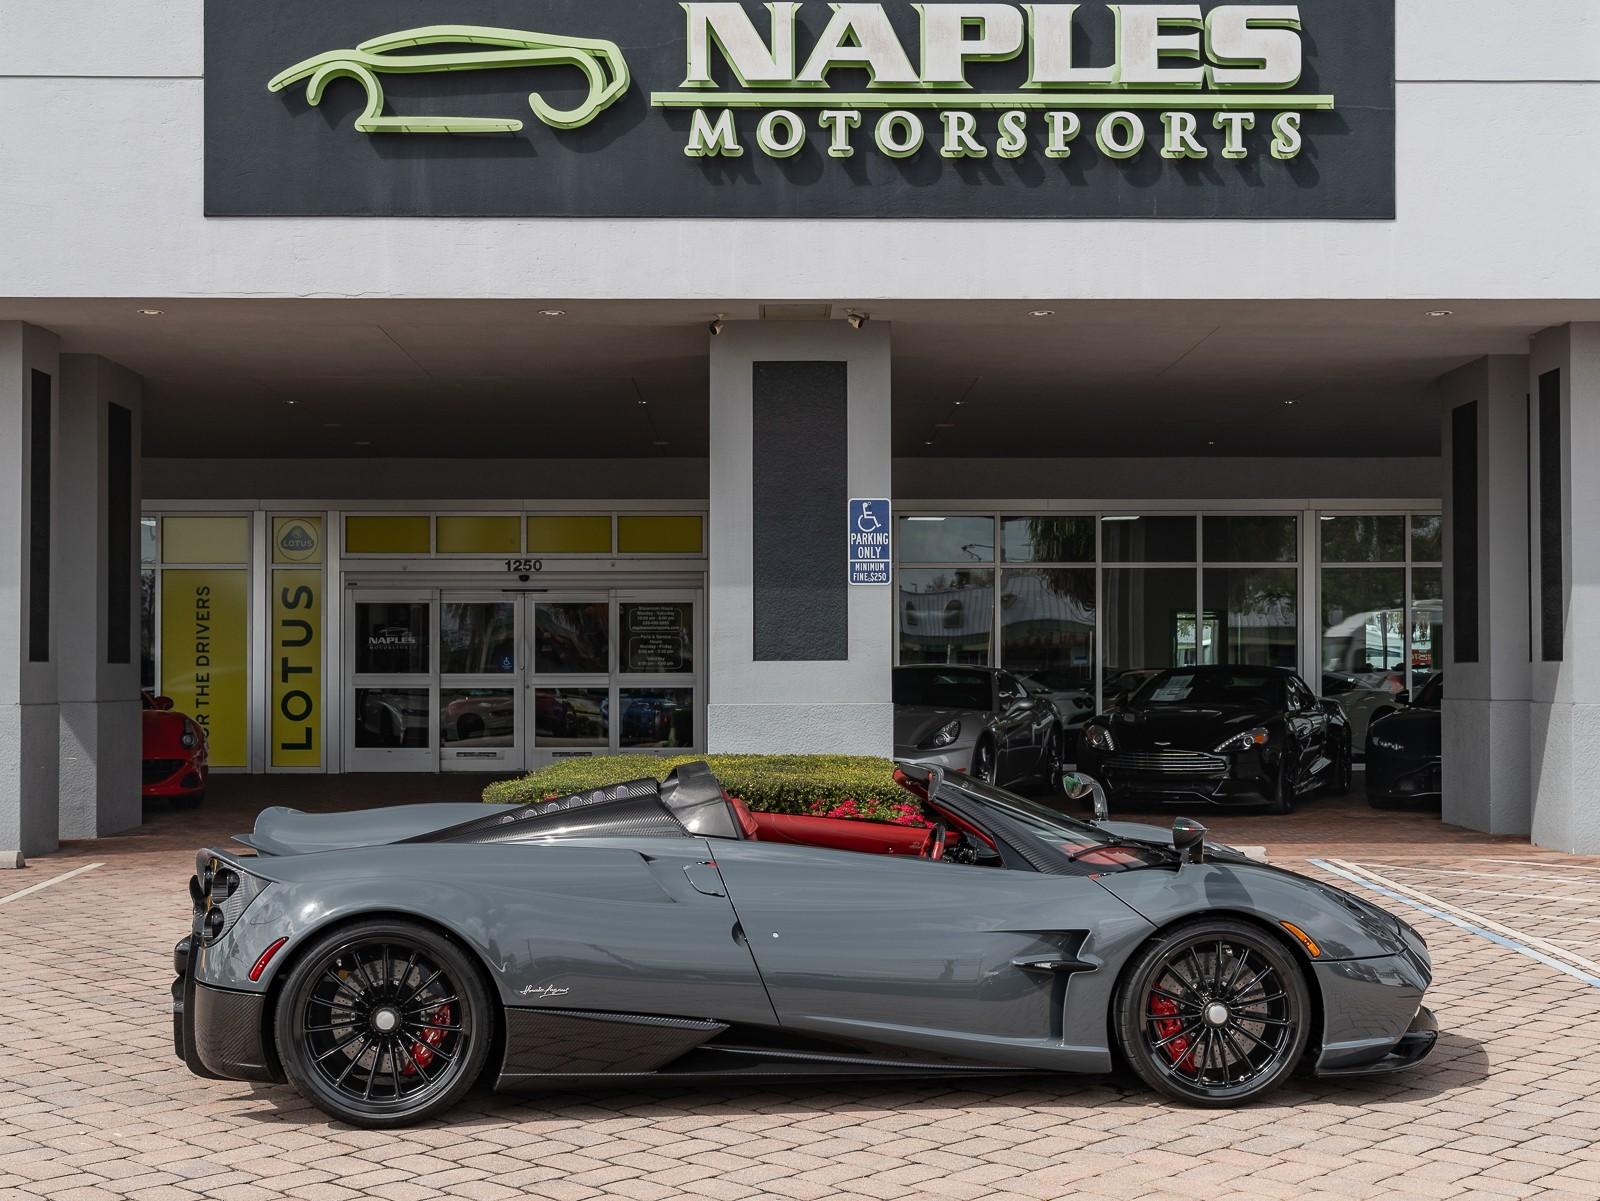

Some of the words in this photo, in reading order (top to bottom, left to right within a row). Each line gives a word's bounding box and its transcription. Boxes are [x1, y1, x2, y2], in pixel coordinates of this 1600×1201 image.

[680, 1, 1303, 90] NAPLES
[684, 108, 1303, 159] MOTORSPORTS
[850, 532, 888, 544] PARKING
[858, 546, 882, 558] ONLY
[504, 560, 543, 571] 1250
[855, 562, 884, 570] MINIMUM
[196, 585, 210, 667] DRIVERS
[282, 585, 314, 750] LOTUS
[196, 672, 210, 709] THE
